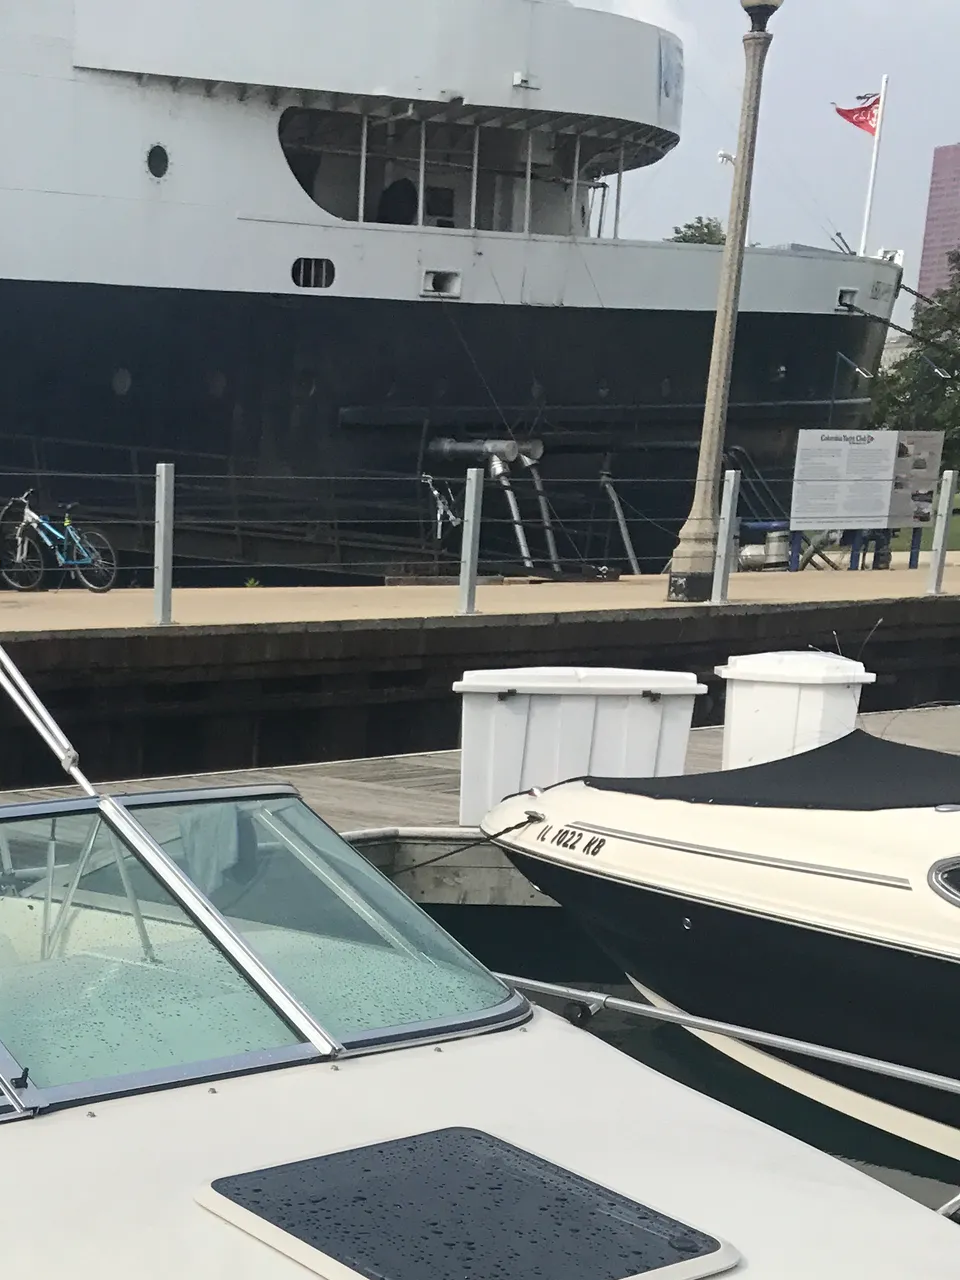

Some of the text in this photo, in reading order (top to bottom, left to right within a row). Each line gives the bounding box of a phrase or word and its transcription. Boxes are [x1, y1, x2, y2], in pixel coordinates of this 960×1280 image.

[856, 434, 867, 442] Club
[536, 825, 606, 857] IL 1022 KB
